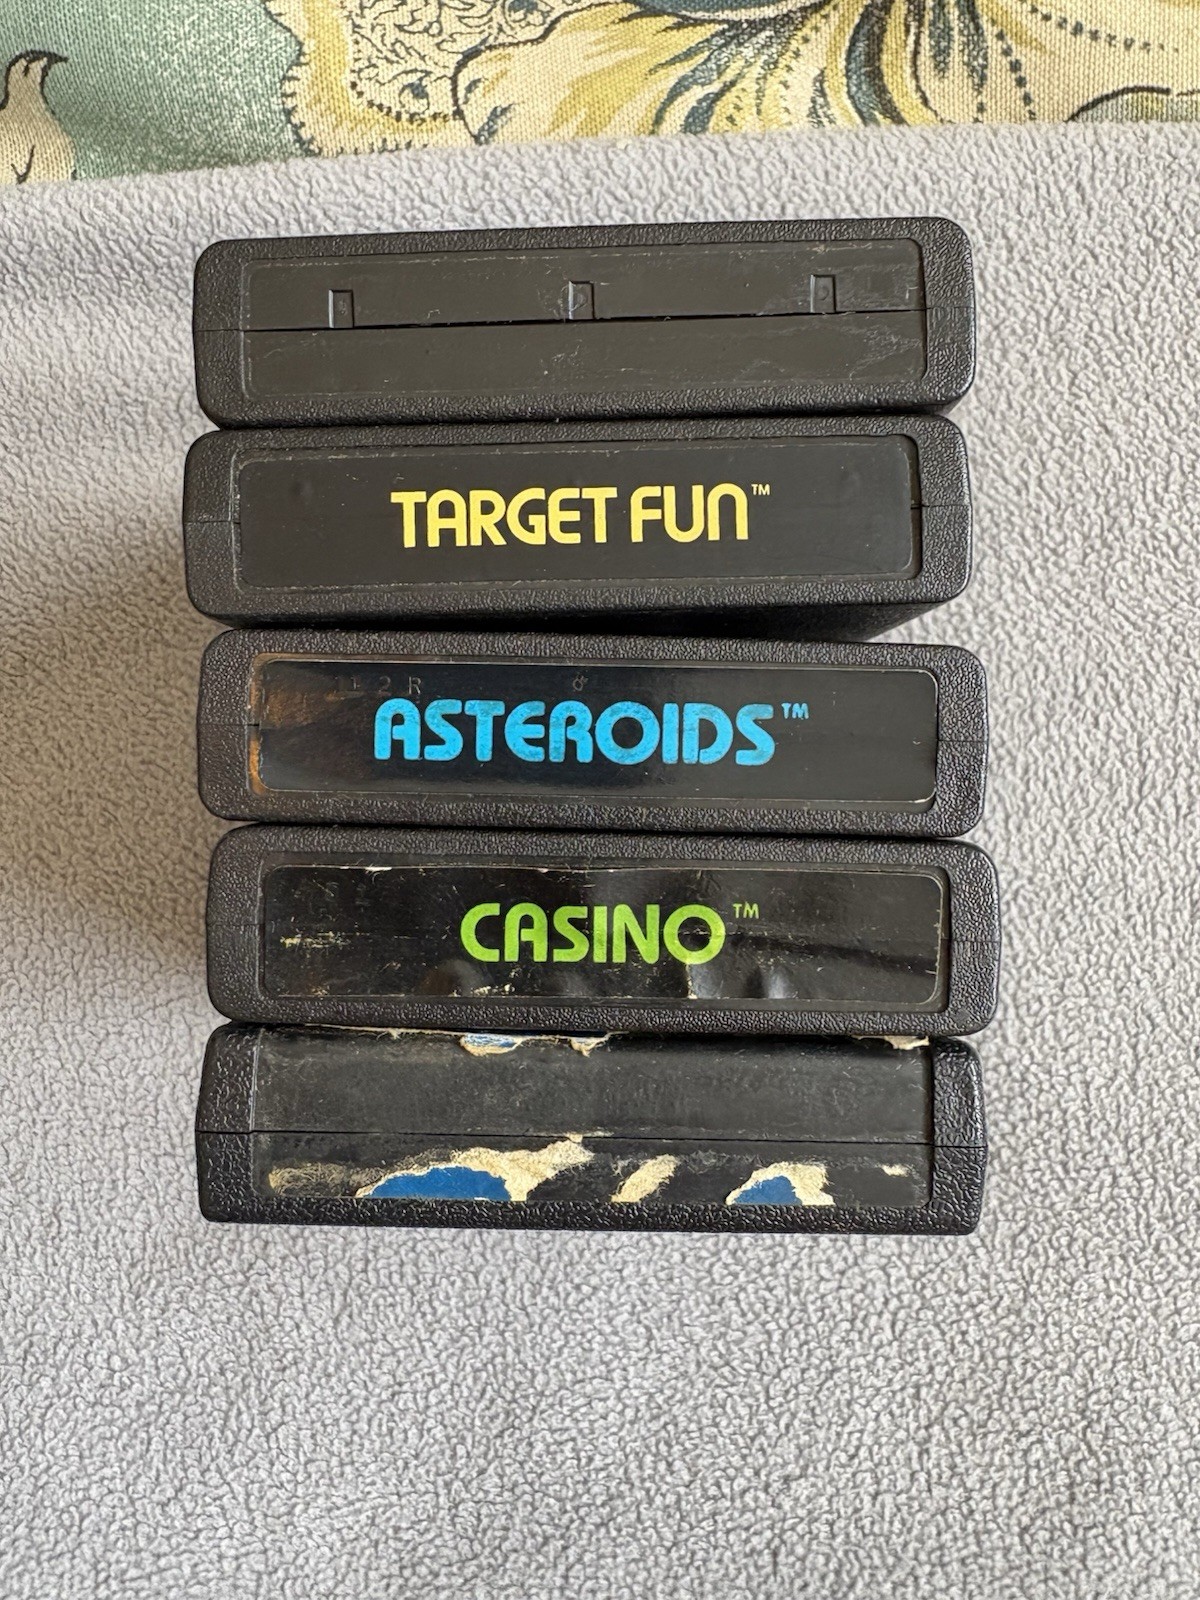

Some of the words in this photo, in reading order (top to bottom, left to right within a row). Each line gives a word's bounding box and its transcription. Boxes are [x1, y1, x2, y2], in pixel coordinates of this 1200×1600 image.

[391, 486, 618, 548] TARGET
[374, 698, 776, 766] ASTEROIDS
[460, 903, 727, 966] CASINO
